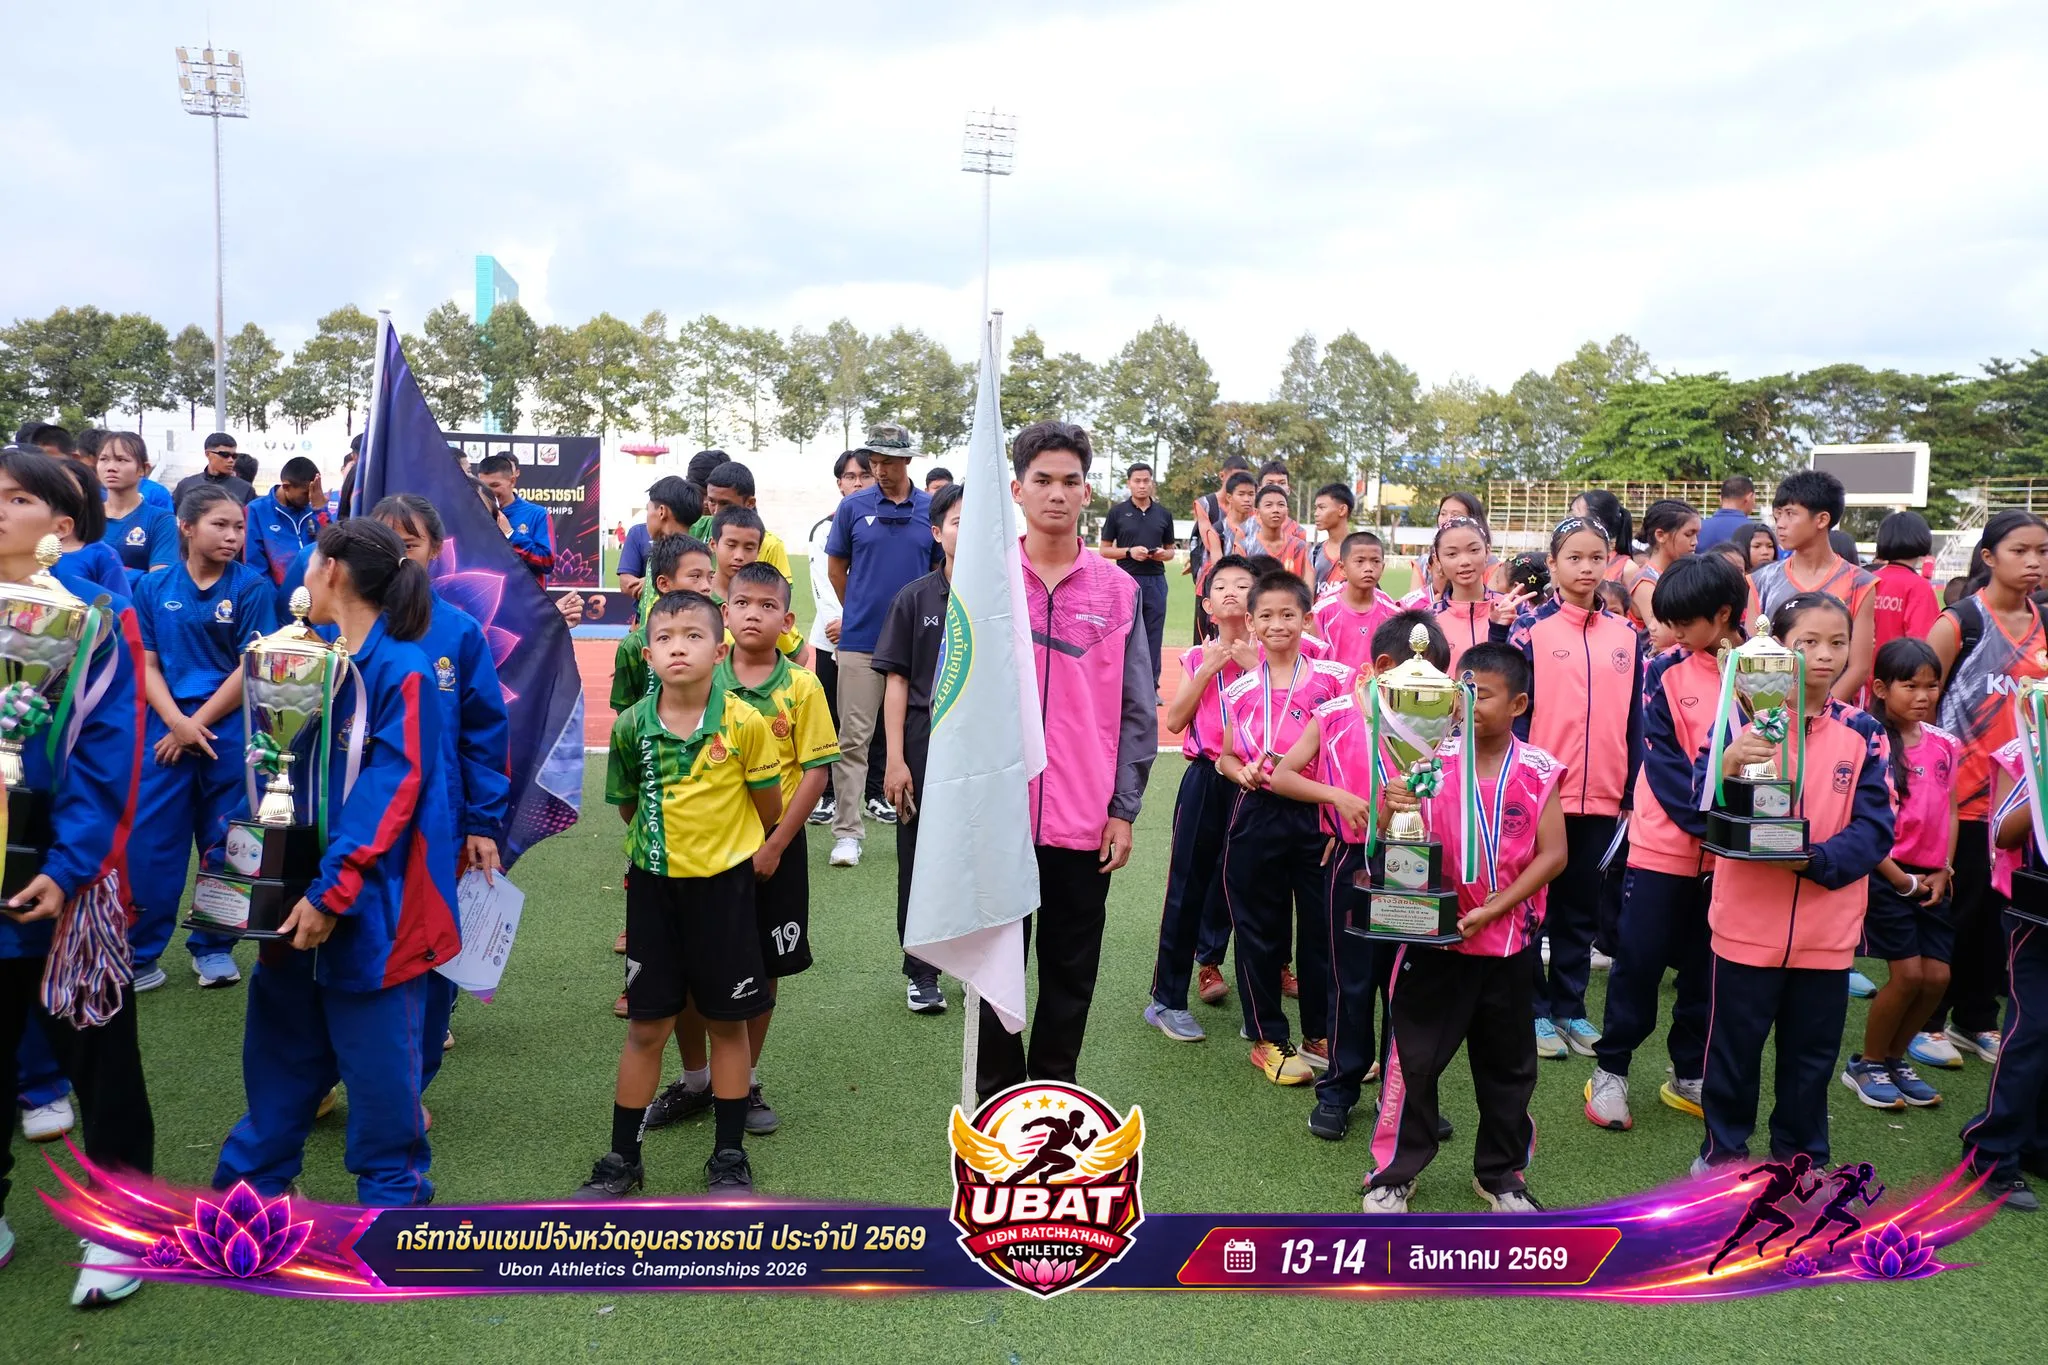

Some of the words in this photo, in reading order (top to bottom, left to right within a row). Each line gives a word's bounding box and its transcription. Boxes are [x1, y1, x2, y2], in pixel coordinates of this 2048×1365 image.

[585, 594, 607, 620] 3
[1986, 672, 2020, 696] KN
[771, 921, 801, 956] 19
